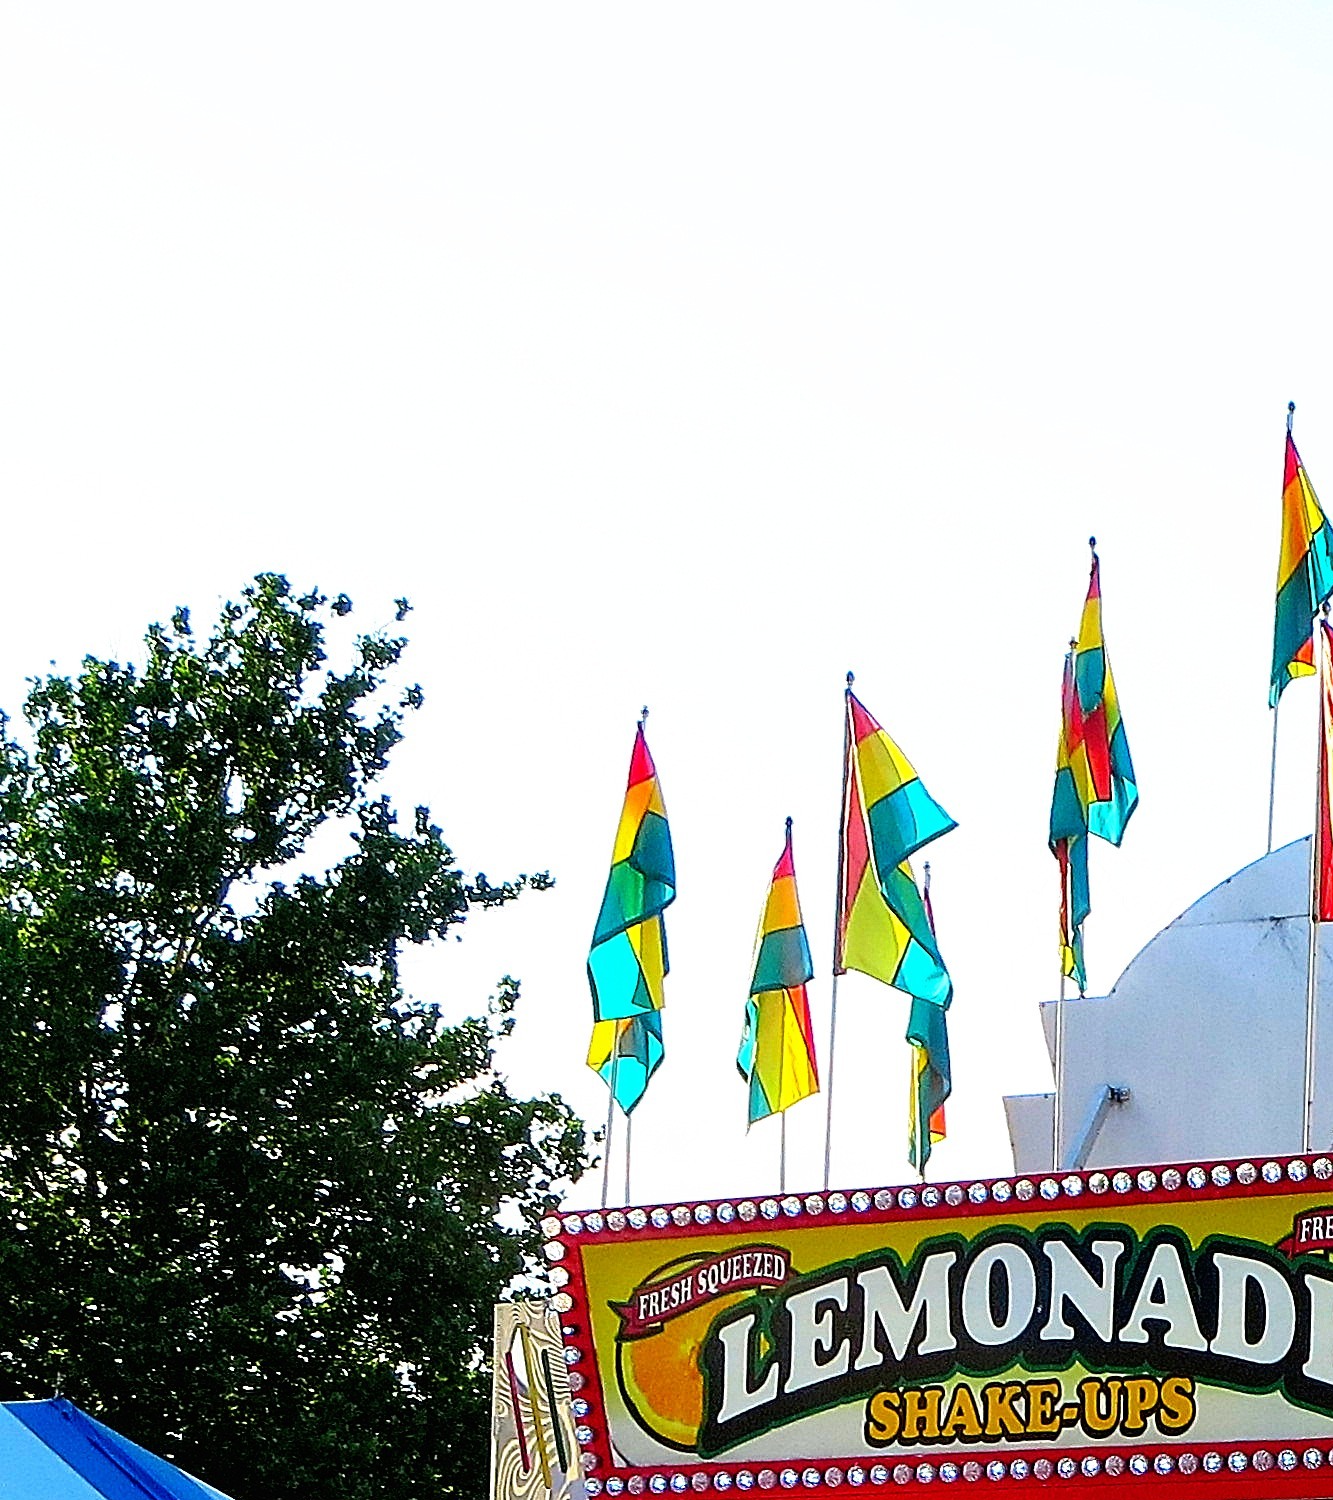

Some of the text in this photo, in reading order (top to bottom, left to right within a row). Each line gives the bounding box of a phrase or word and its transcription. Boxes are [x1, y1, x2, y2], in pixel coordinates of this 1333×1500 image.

[637, 1250, 786, 1322] FRESH SQUEEZED
[867, 1377, 1197, 1439] SHAKE-UPS
